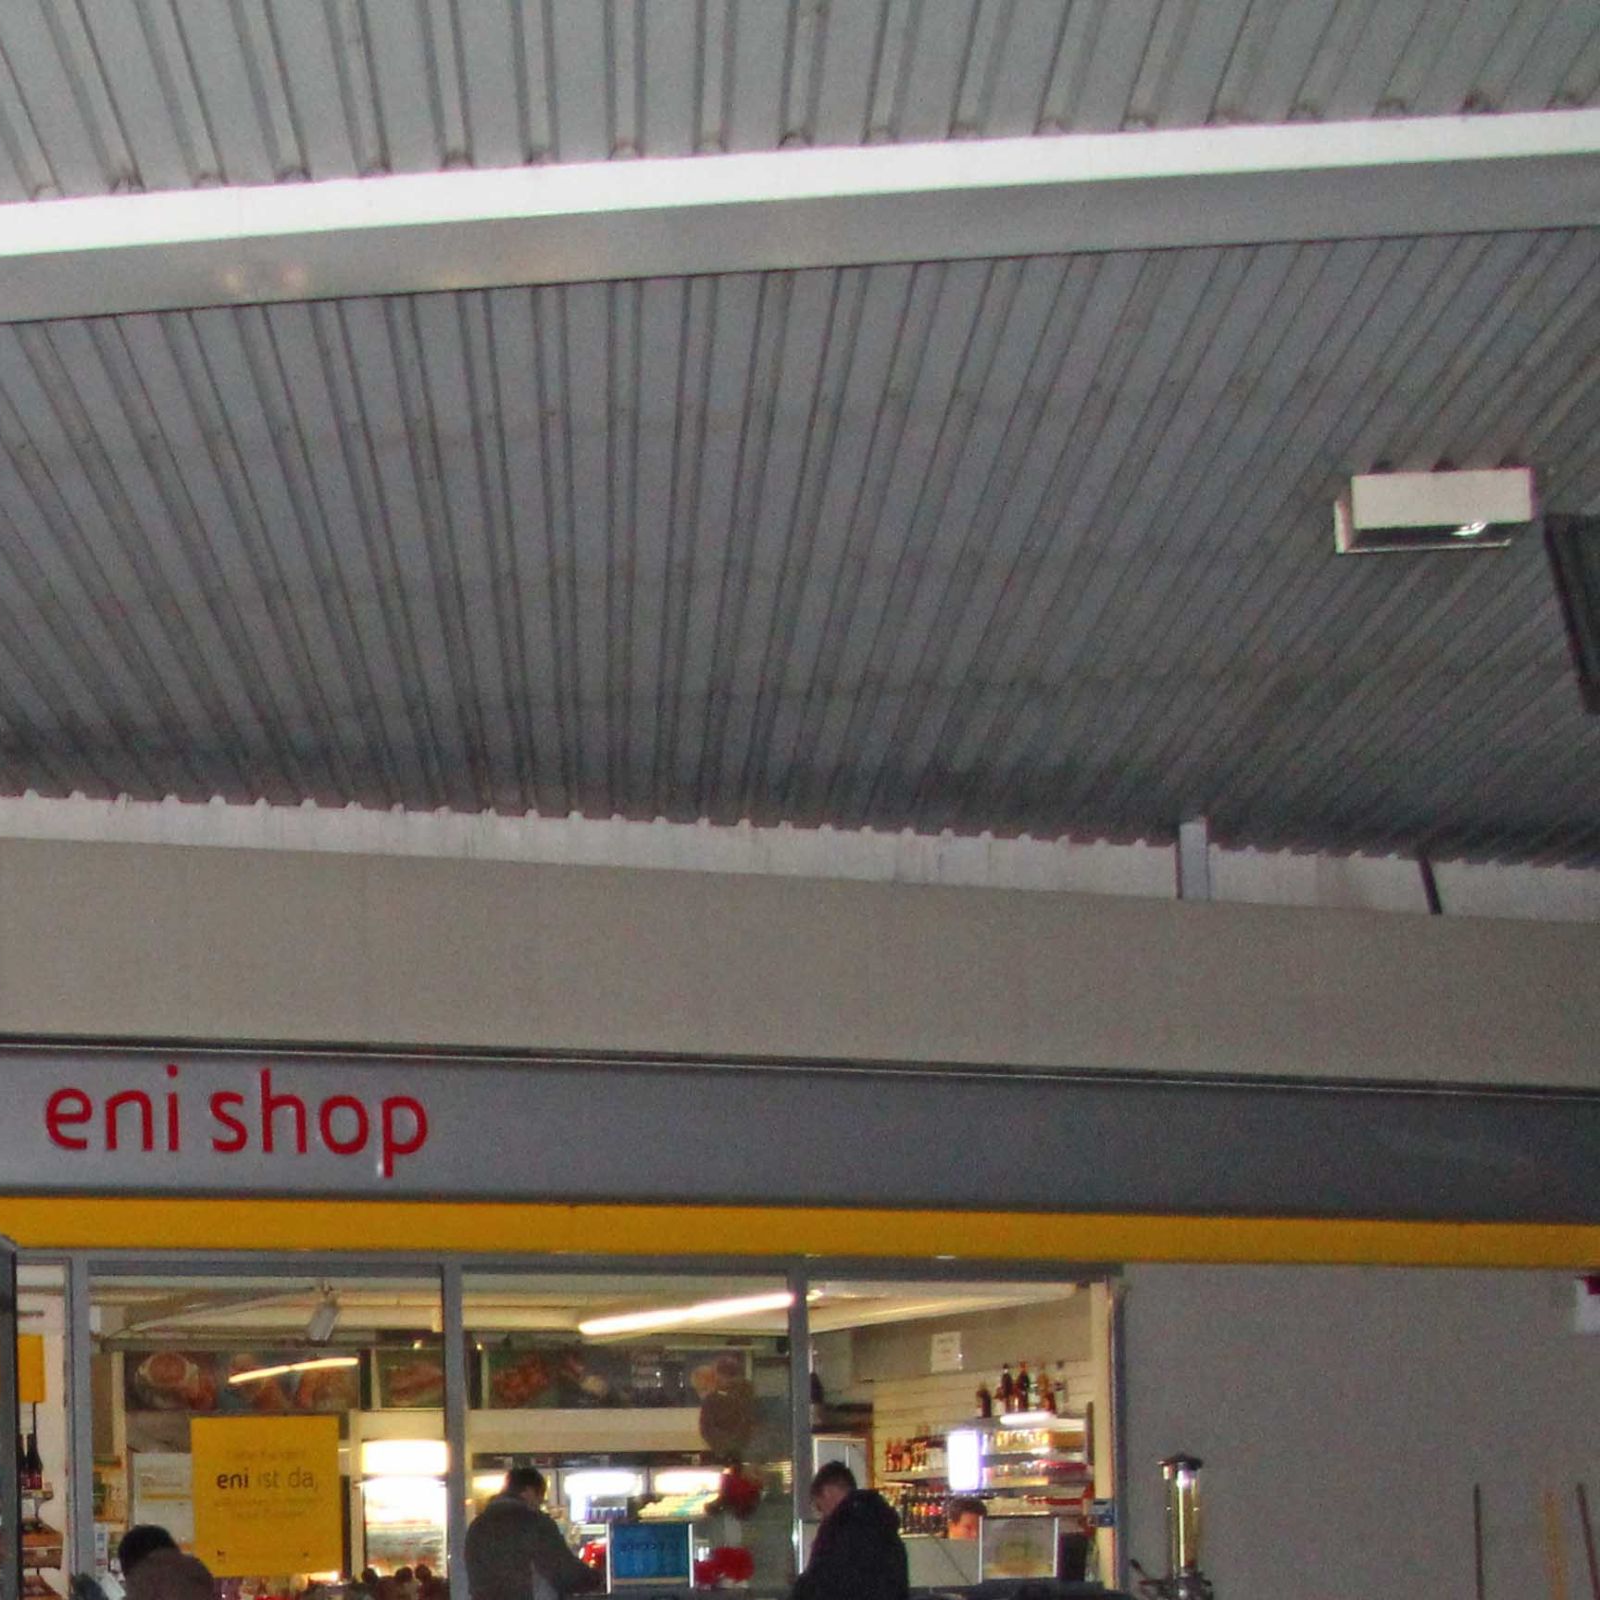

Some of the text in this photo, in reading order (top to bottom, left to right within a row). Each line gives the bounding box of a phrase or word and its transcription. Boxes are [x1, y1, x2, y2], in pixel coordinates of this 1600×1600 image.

[46, 1063, 428, 1178] eni shop
[216, 1468, 249, 1489] eni
[257, 1468, 280, 1489] ist
